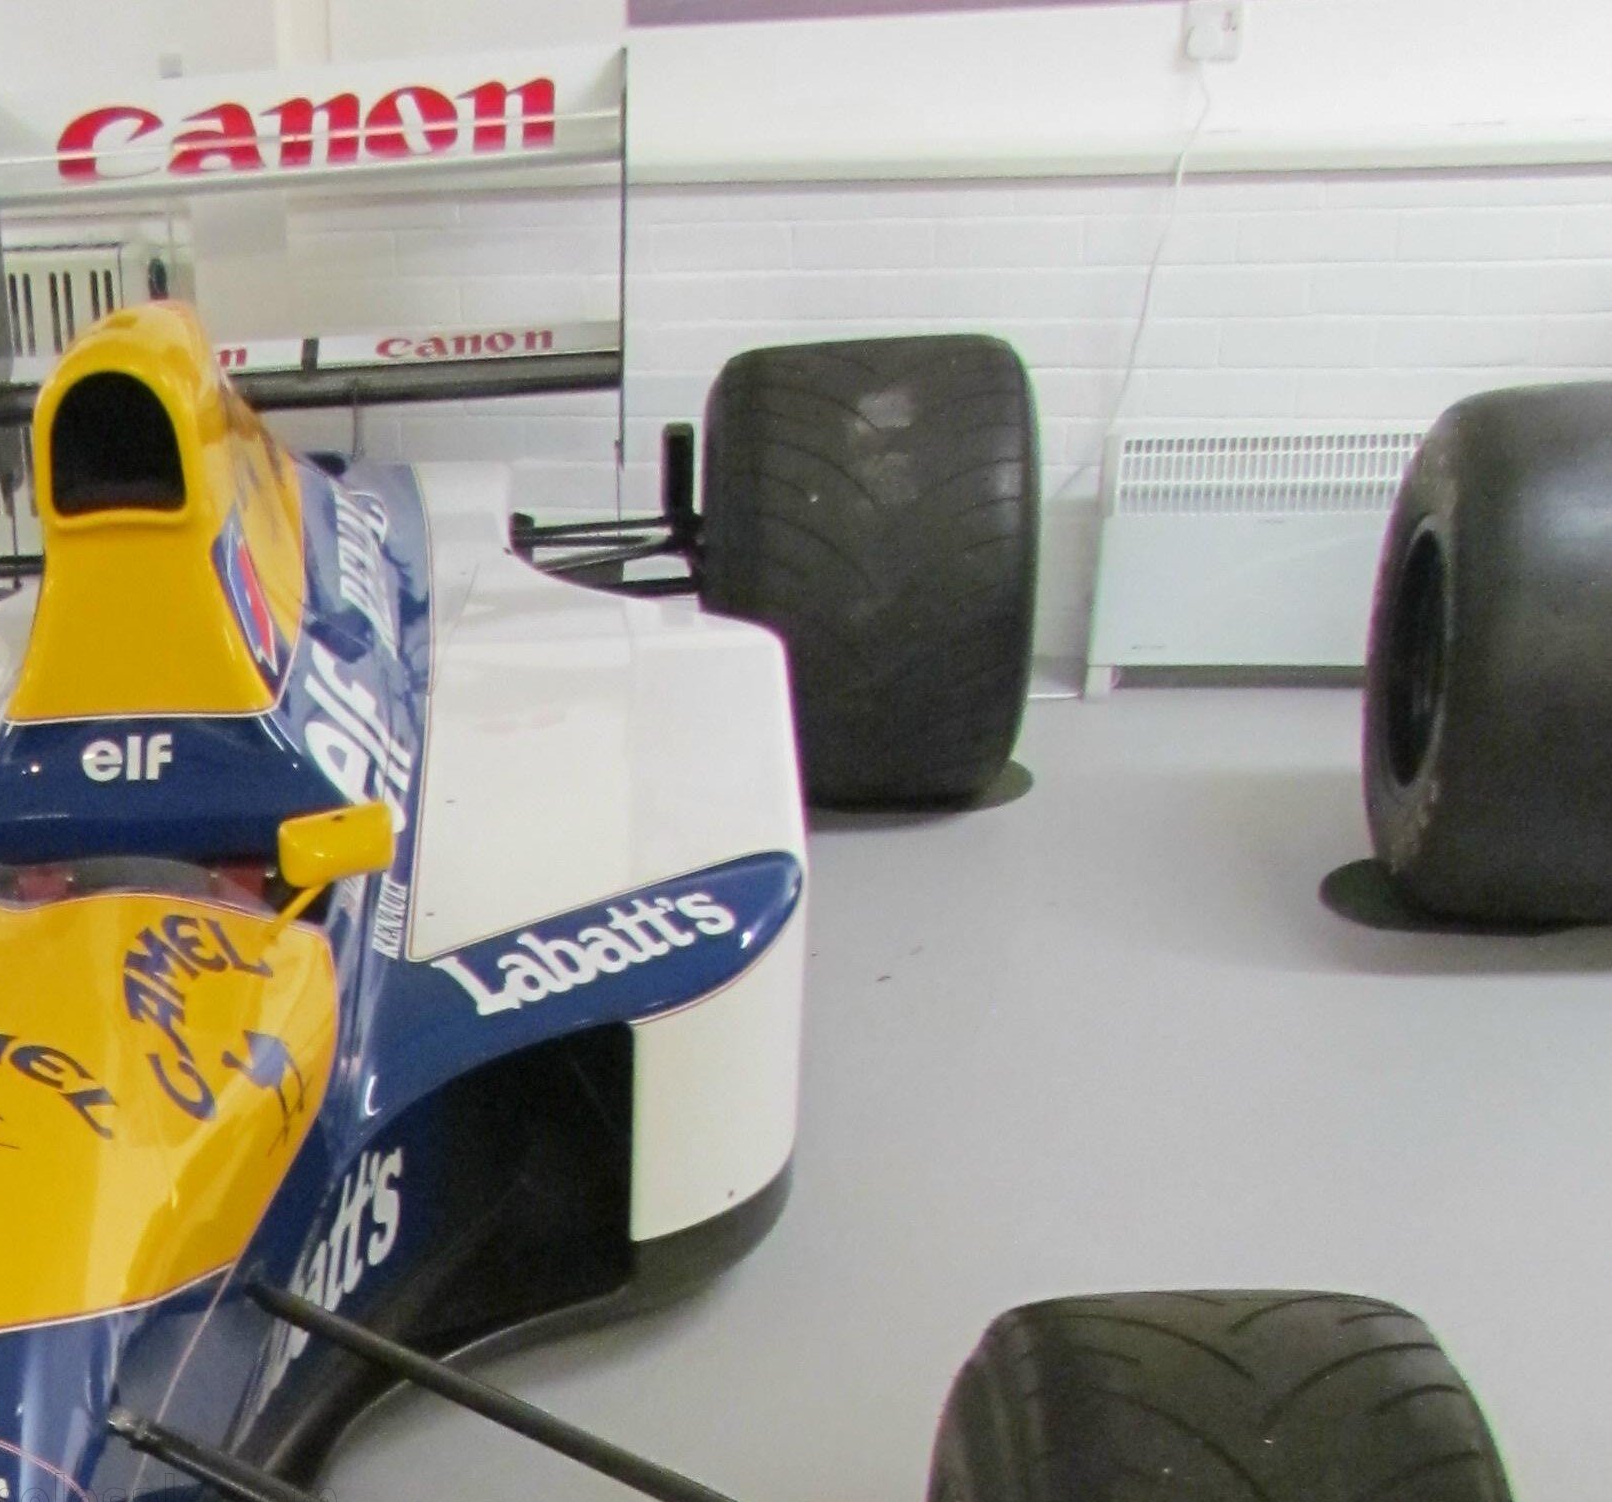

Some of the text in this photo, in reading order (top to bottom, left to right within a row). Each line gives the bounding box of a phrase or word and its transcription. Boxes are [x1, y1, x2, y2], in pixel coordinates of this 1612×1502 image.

[57, 76, 556, 184] Canon
[375, 328, 554, 360] Canon
[80, 733, 174, 783] elf
[430, 892, 737, 1018] Labatt's
[122, 913, 275, 1122] CAMEL
